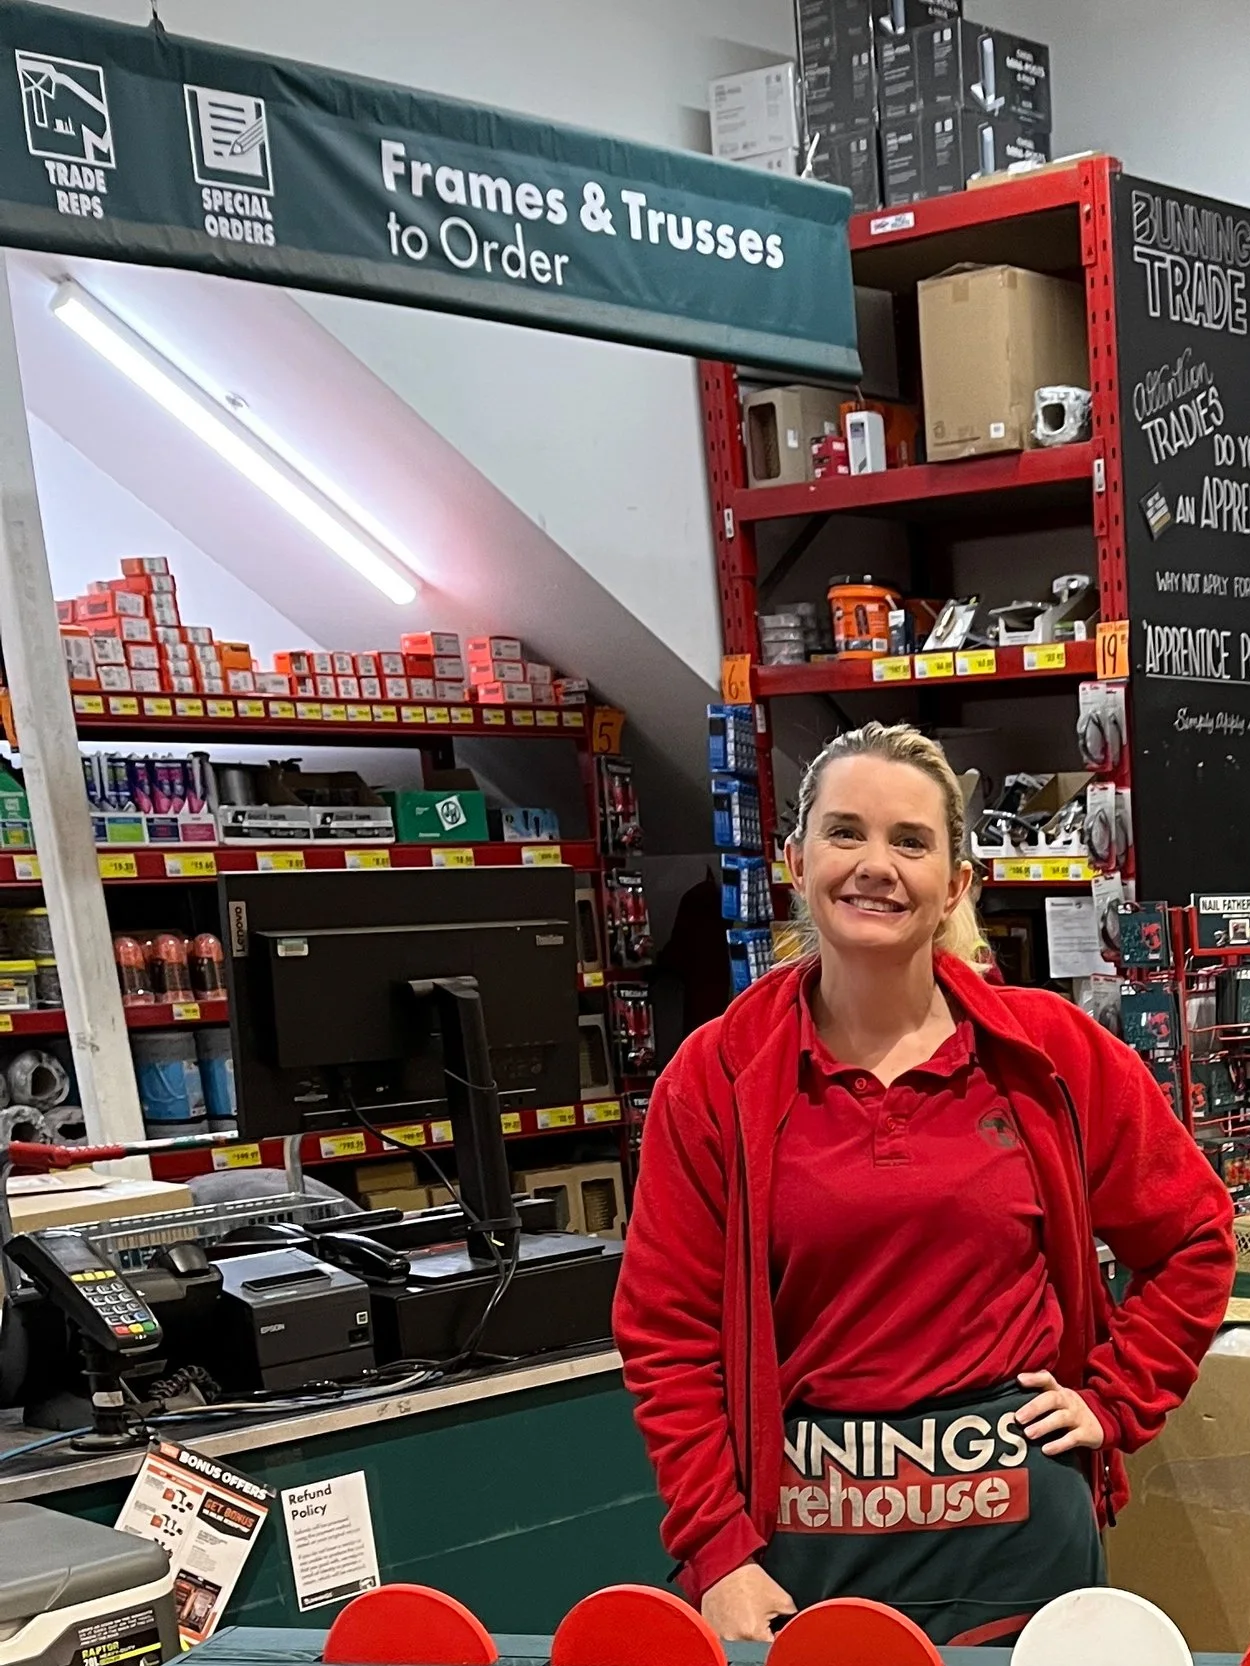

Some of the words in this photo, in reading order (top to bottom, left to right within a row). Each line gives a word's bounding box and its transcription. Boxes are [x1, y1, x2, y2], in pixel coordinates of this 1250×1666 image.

[45, 160, 107, 194] TRADE
[56, 189, 104, 219] REPS
[201, 187, 274, 221] SPECIAL
[381, 138, 568, 226] Frames
[579, 181, 617, 236] &
[621, 189, 785, 269] Trusses
[204, 214, 277, 246] ORDERS
[387, 211, 429, 261] to
[439, 216, 570, 287] Order
[1133, 245, 1248, 335] TRADE
[1141, 385, 1224, 465] TRADIES
[1213, 433, 1235, 467] DO
[1175, 494, 1196, 525] AN
[1156, 570, 1180, 592] WHY
[1181, 573, 1201, 593] NOT
[1202, 574, 1229, 596] APPLY
[1146, 625, 1231, 680] APPRENTICE
[235, 906, 246, 953] Lenovo
[178, 1451, 221, 1480] BONUS
[221, 1471, 268, 1501] OFFERS
[289, 1484, 332, 1505] Refund
[291, 1503, 328, 1520] Policy
[778, 1466, 1010, 1528] rehouse
[204, 1498, 224, 1514] GET
[224, 1507, 255, 1528] BONUS
[82, 1641, 119, 1660] RAPTOR
